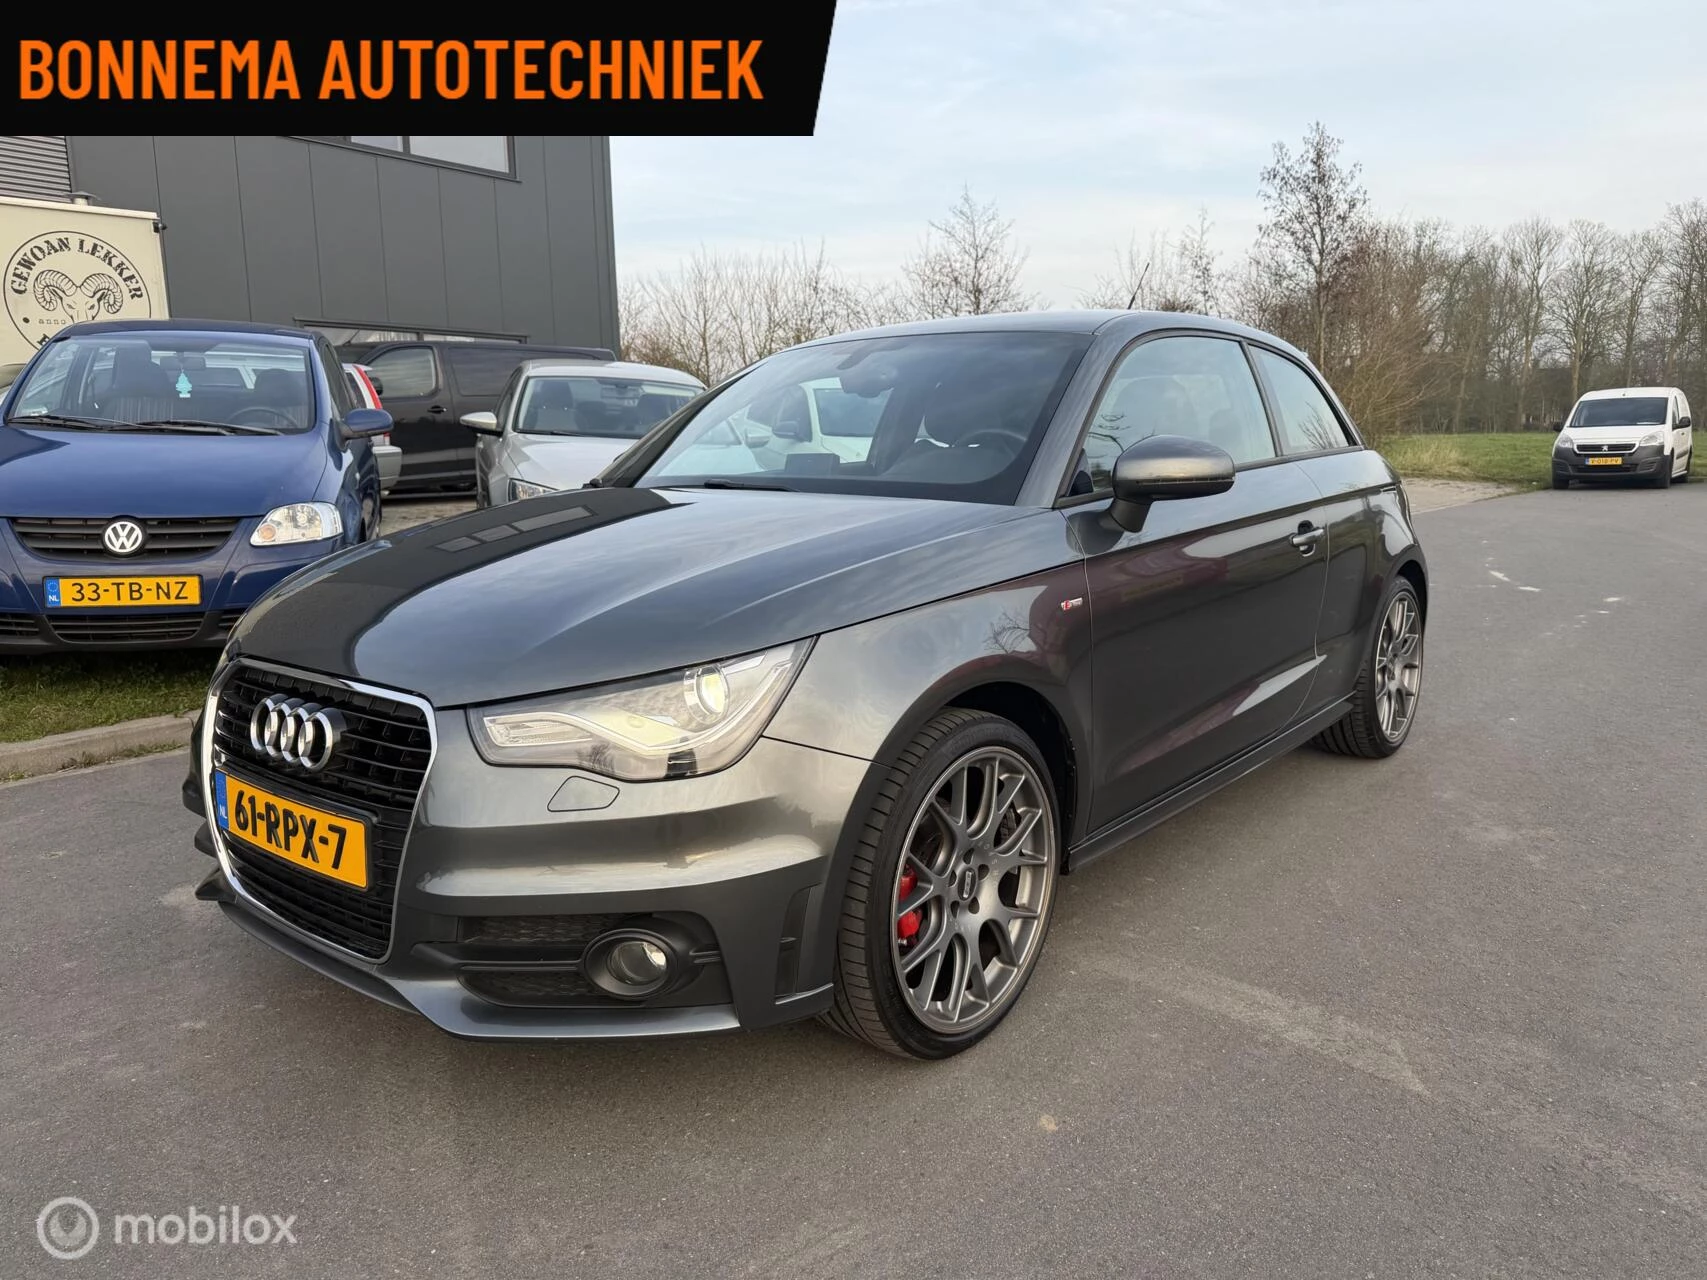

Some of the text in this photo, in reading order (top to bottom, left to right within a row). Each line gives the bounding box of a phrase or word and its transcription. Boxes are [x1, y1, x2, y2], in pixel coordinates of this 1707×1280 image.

[10, 236, 144, 300] GEWOAN LEKKER
[38, 317, 67, 325] anno
[48, 581, 189, 602] NL 33-TB-NZ
[219, 789, 347, 870] NL 61-RPX-7
